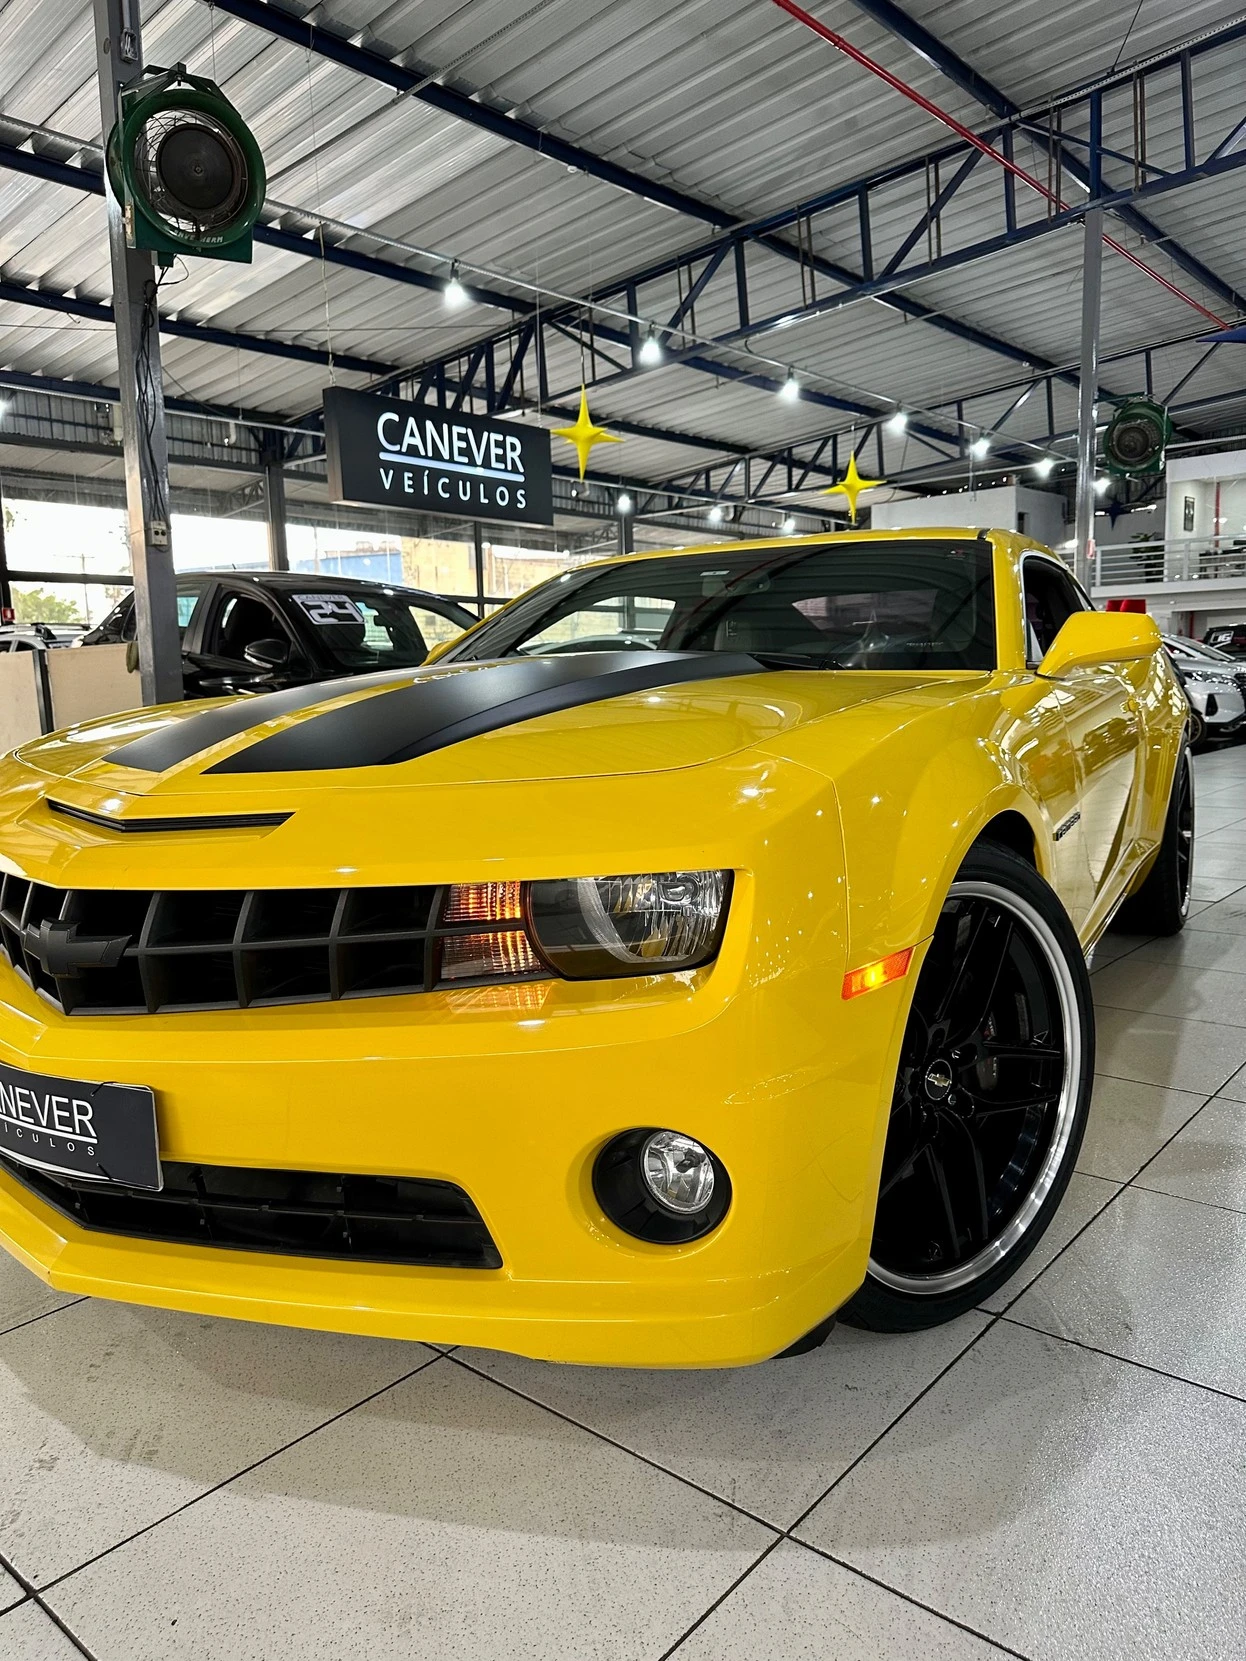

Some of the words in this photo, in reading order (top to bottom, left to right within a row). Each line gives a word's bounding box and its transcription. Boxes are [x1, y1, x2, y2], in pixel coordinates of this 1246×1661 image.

[377, 412, 525, 473] CANEVER
[379, 467, 527, 509] VEÍCULOS
[304, 601, 364, 623] 24
[0, 1081, 97, 1138] NEVER
